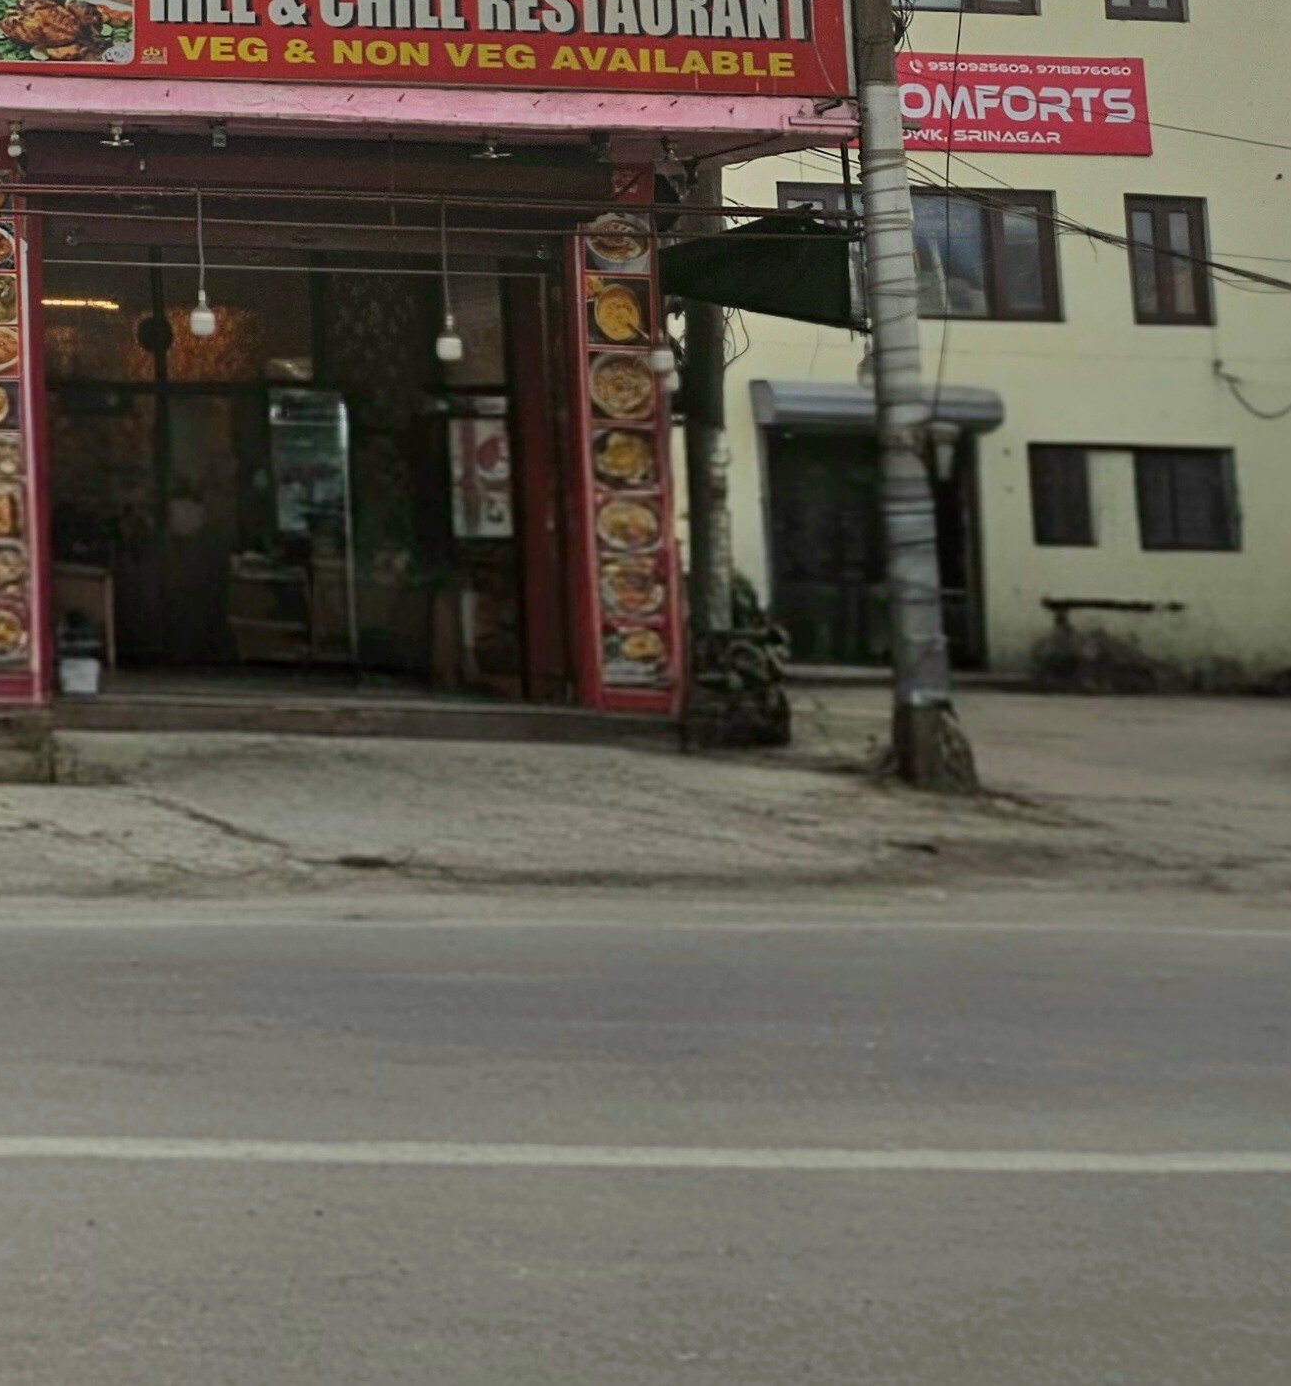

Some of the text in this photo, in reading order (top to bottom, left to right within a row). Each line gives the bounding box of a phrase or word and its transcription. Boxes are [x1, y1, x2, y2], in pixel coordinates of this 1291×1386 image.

[177, 36, 269, 64] VEG
[283, 39, 315, 64] &
[333, 39, 430, 68] NON
[444, 42, 536, 70] VEG
[550, 45, 796, 78] AVAILABLE
[899, 82, 1136, 124] OMFORTS
[953, 129, 1062, 144] SRINAGAR
